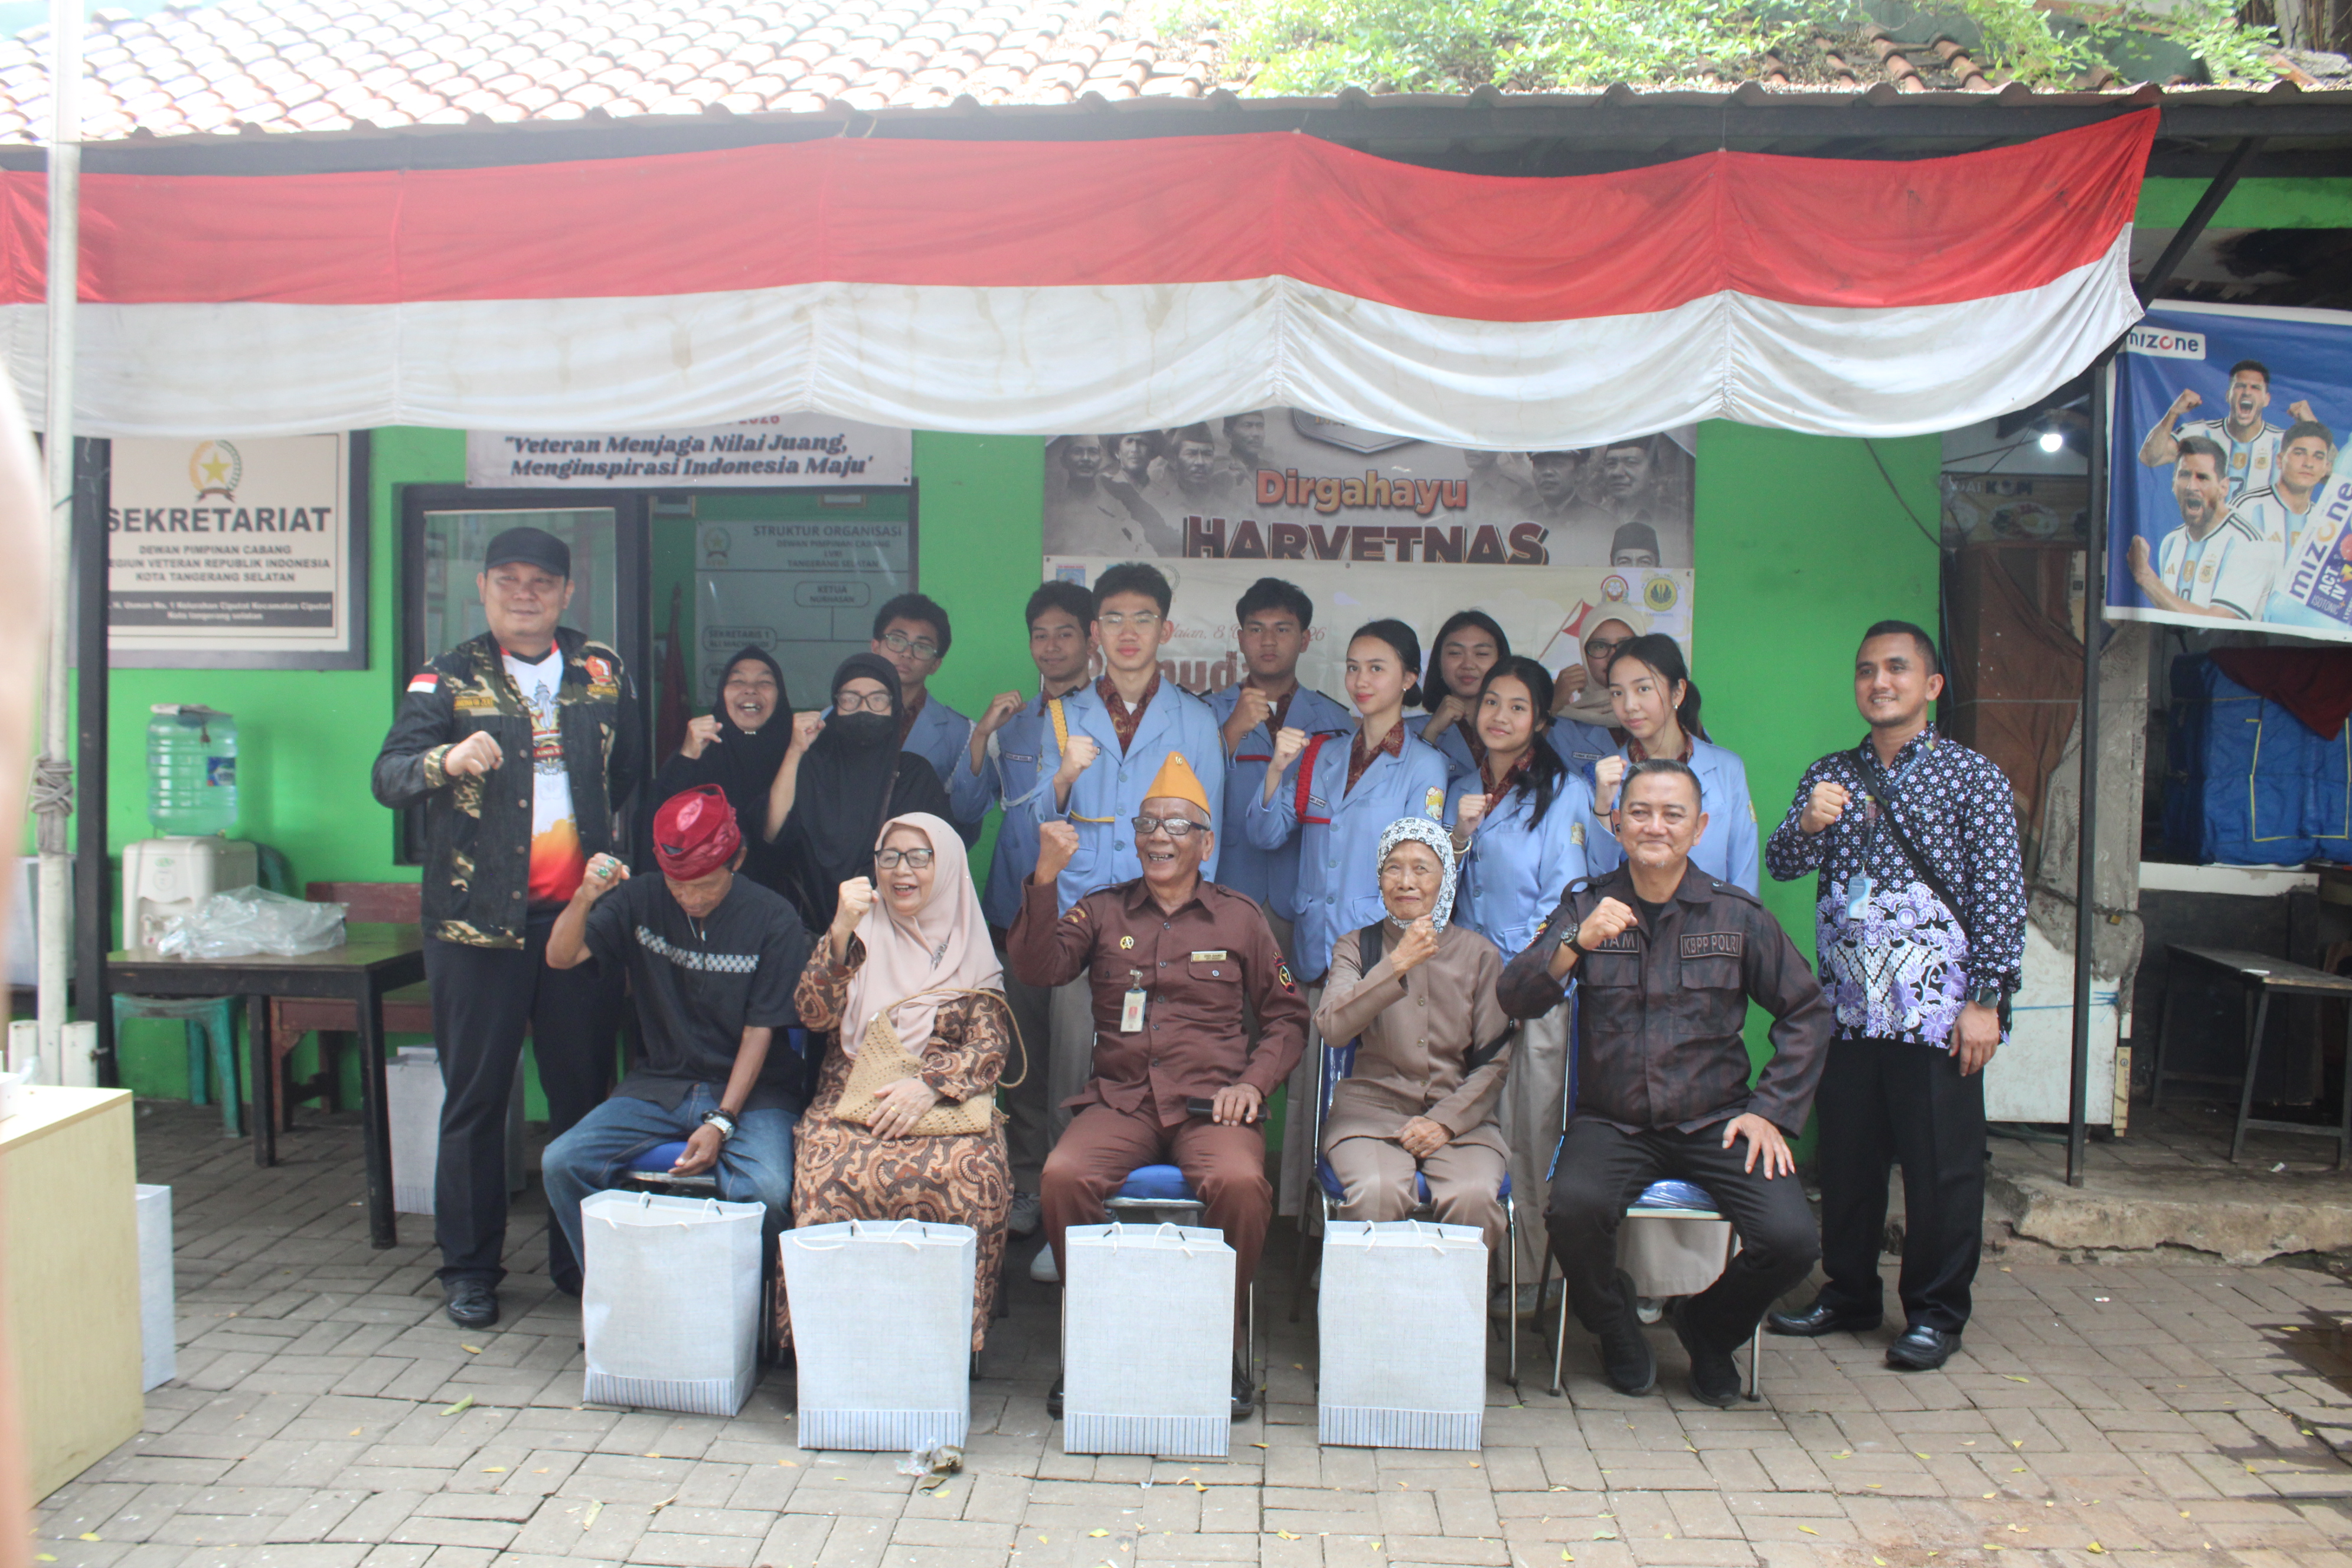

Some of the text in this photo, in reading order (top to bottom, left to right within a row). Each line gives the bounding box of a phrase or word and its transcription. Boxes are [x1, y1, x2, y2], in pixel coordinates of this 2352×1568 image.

[606, 434, 705, 457] Menjaga
[710, 433, 766, 452] Nilai
[767, 433, 847, 455] Juang,
[511, 458, 680, 480] Menginspirasi
[683, 455, 799, 475] Indonesia
[1256, 468, 1469, 515] Dirgahayu
[109, 507, 332, 533] SEKRETARIAT
[753, 525, 901, 537] STRUKTUR ORGANISASI
[139, 545, 292, 554] DEWAN PIMPINAN CABANG
[1182, 515, 1550, 565] HARVETNAS
[2289, 481, 2352, 600] mizone
[109, 558, 330, 568] EGIUN VETERAN REPUBLIK INDONESIA
[136, 572, 295, 582] KOTA TANGERANG SELATAN
[1684, 935, 1739, 955] KBPP POLRI
